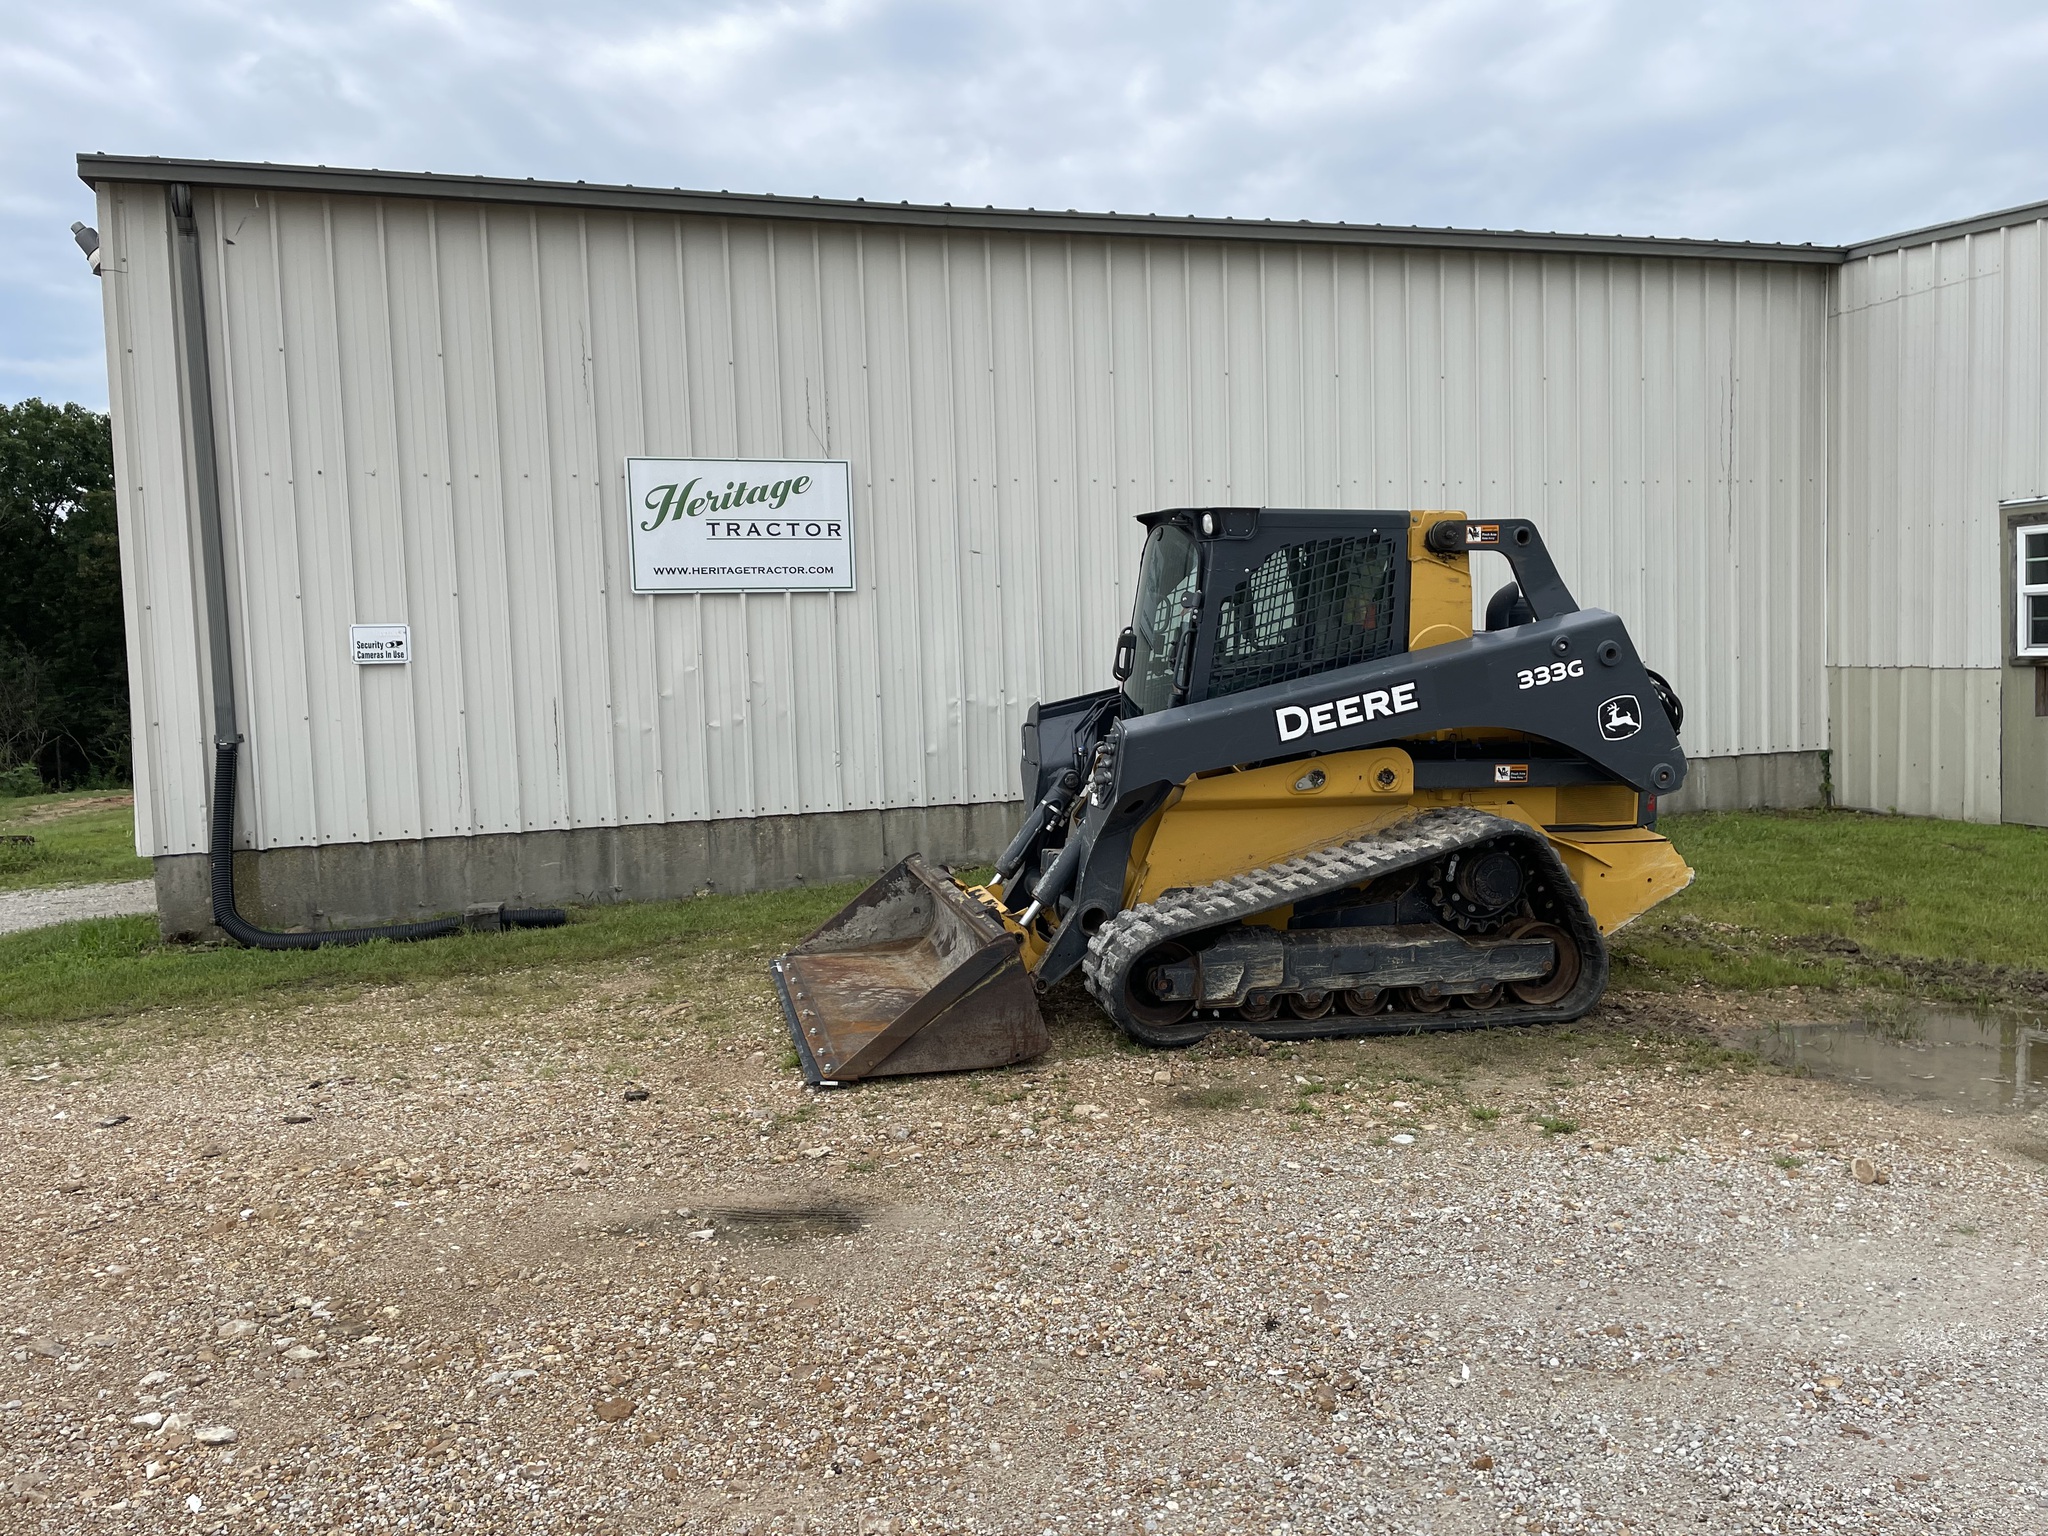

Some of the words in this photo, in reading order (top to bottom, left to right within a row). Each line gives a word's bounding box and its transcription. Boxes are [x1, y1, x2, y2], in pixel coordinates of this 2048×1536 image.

[640, 475, 813, 532] Heritage
[706, 522, 842, 537] TRACTOR
[653, 566, 834, 575] WWW.HERITAGETRACTOR.COM
[356, 640, 384, 650] Security
[357, 650, 384, 659] Cameras
[385, 650, 392, 658] In
[392, 650, 405, 659] Use
[1517, 659, 1584, 690] 333G
[1275, 682, 1419, 741] DEERE
